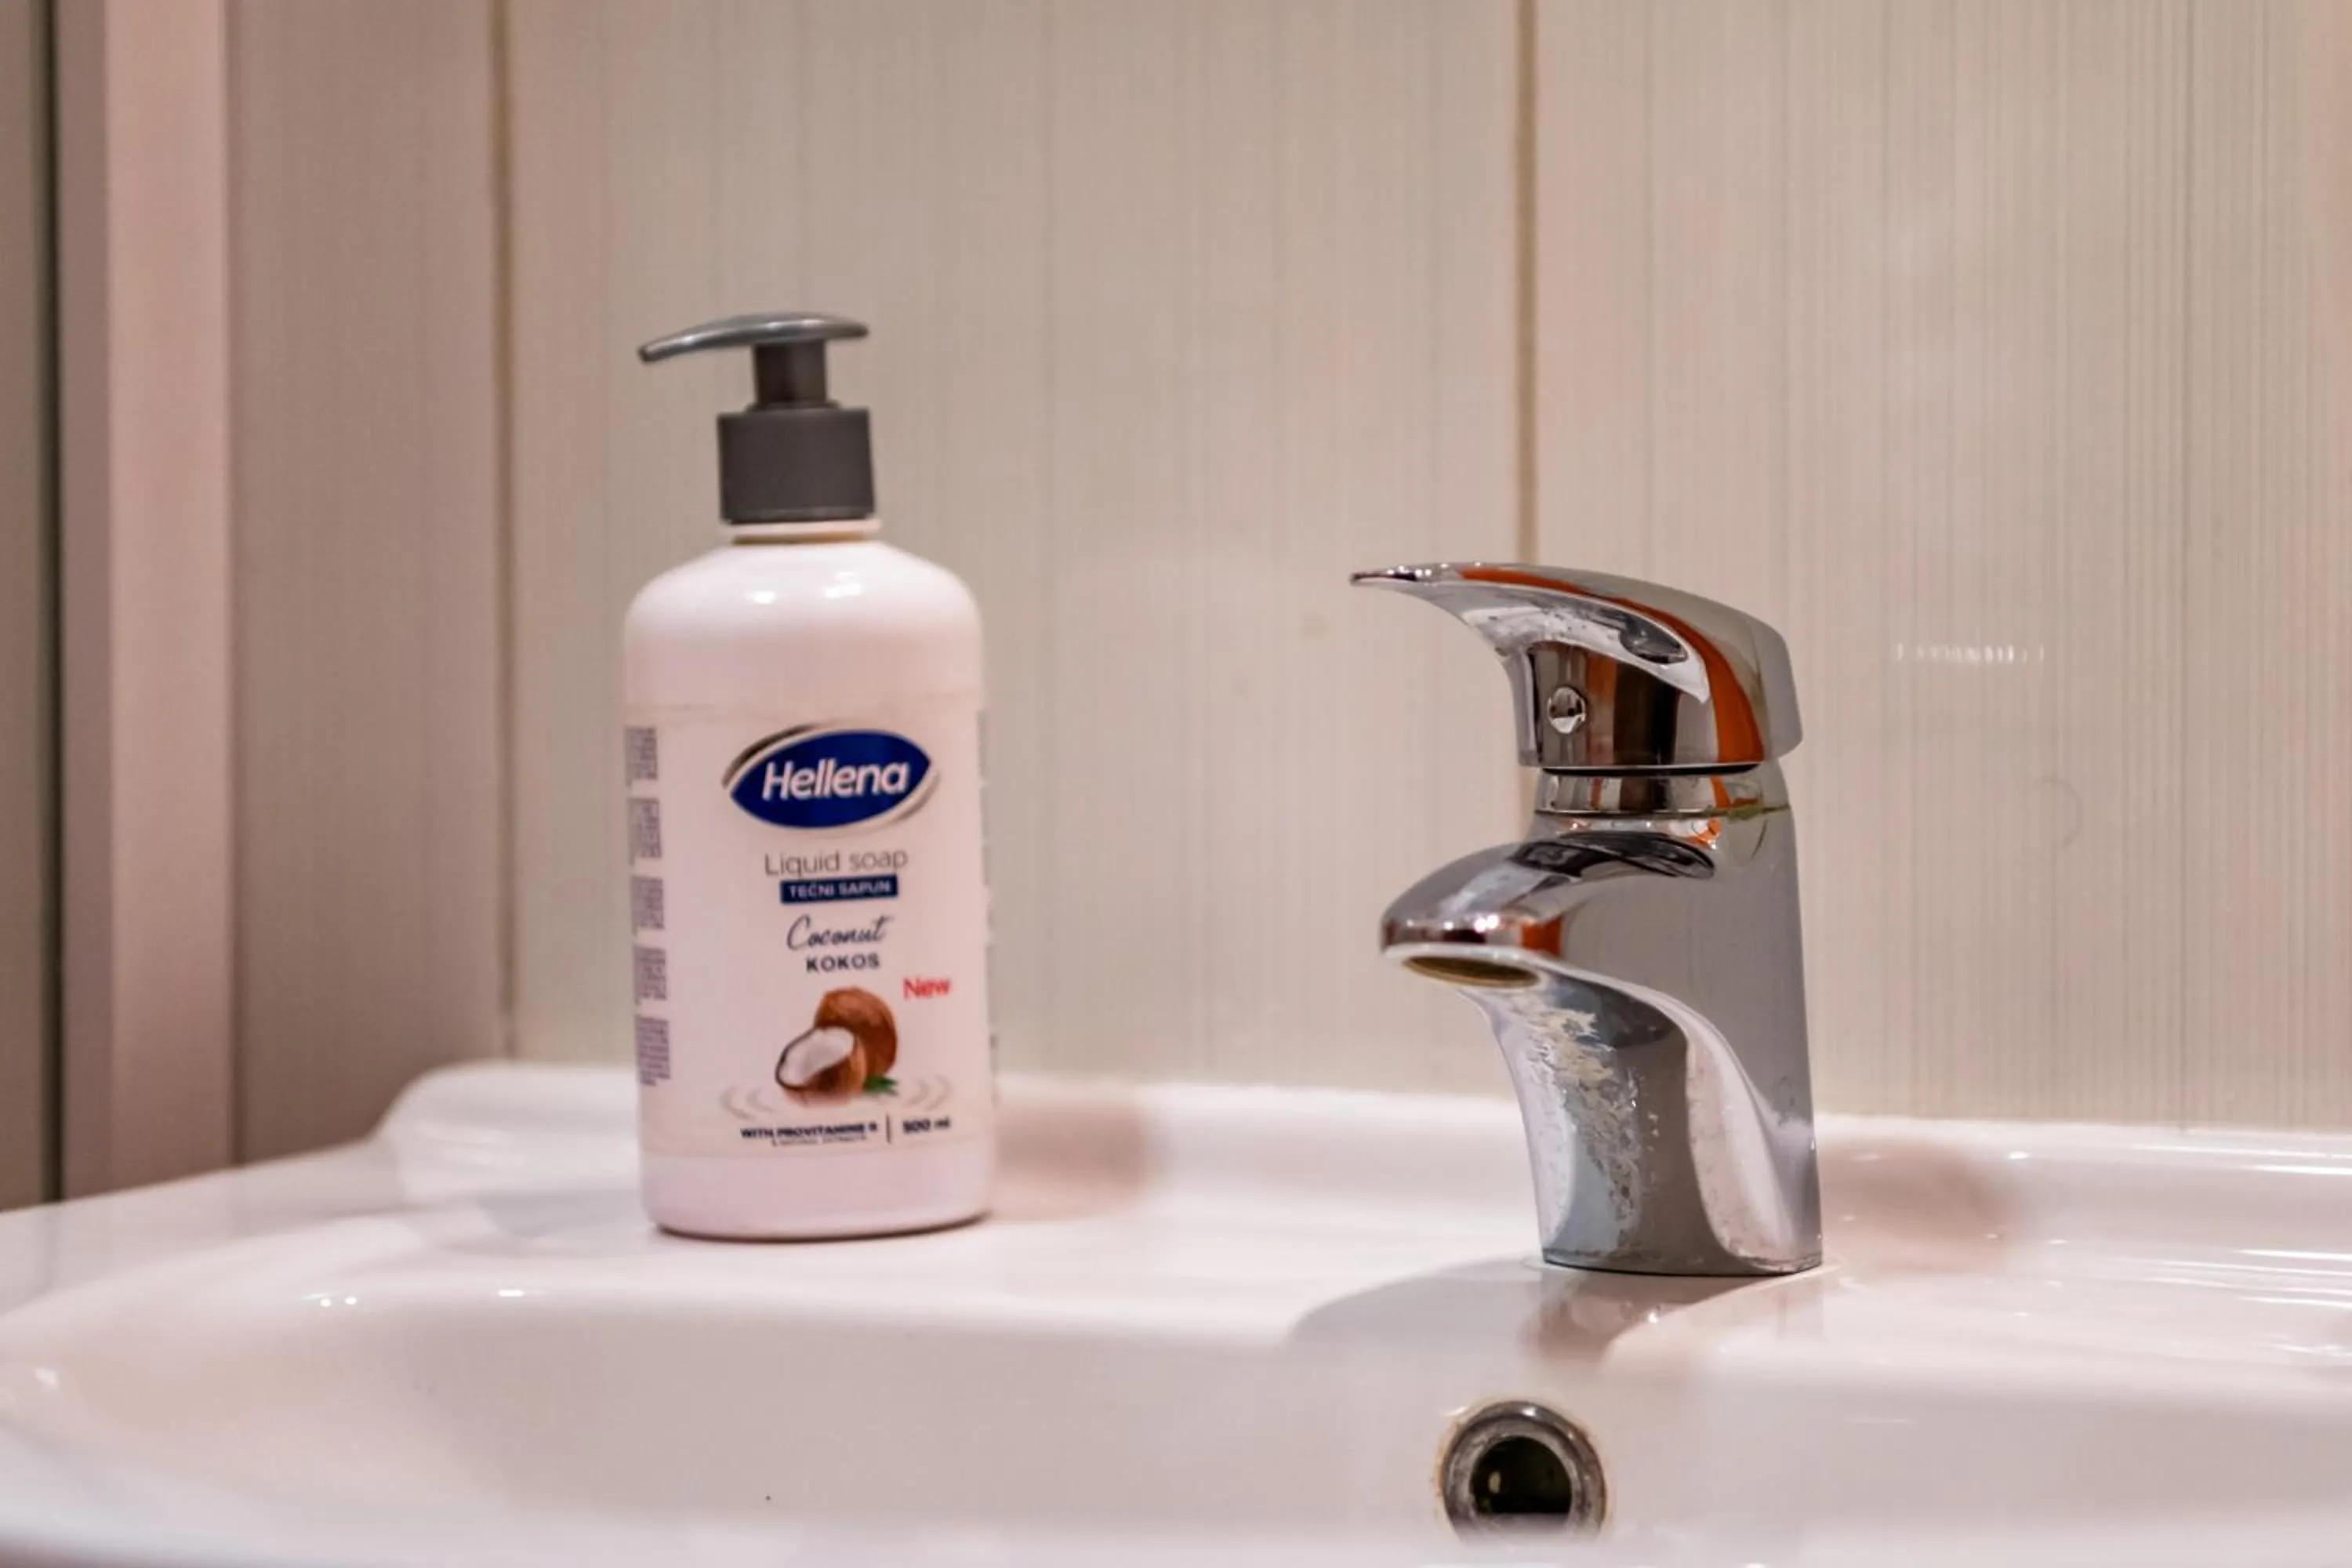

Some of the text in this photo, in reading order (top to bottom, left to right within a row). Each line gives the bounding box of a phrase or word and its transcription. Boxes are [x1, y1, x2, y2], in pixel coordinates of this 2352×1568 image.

[761, 758, 910, 801] Hellena
[764, 850, 909, 877] Liquid soap
[838, 880, 892, 895] SAPUN
[786, 914, 894, 951] Coconut
[806, 953, 880, 972] KOKOS
[903, 977, 951, 1000] New
[741, 1127, 773, 1139] WITH
